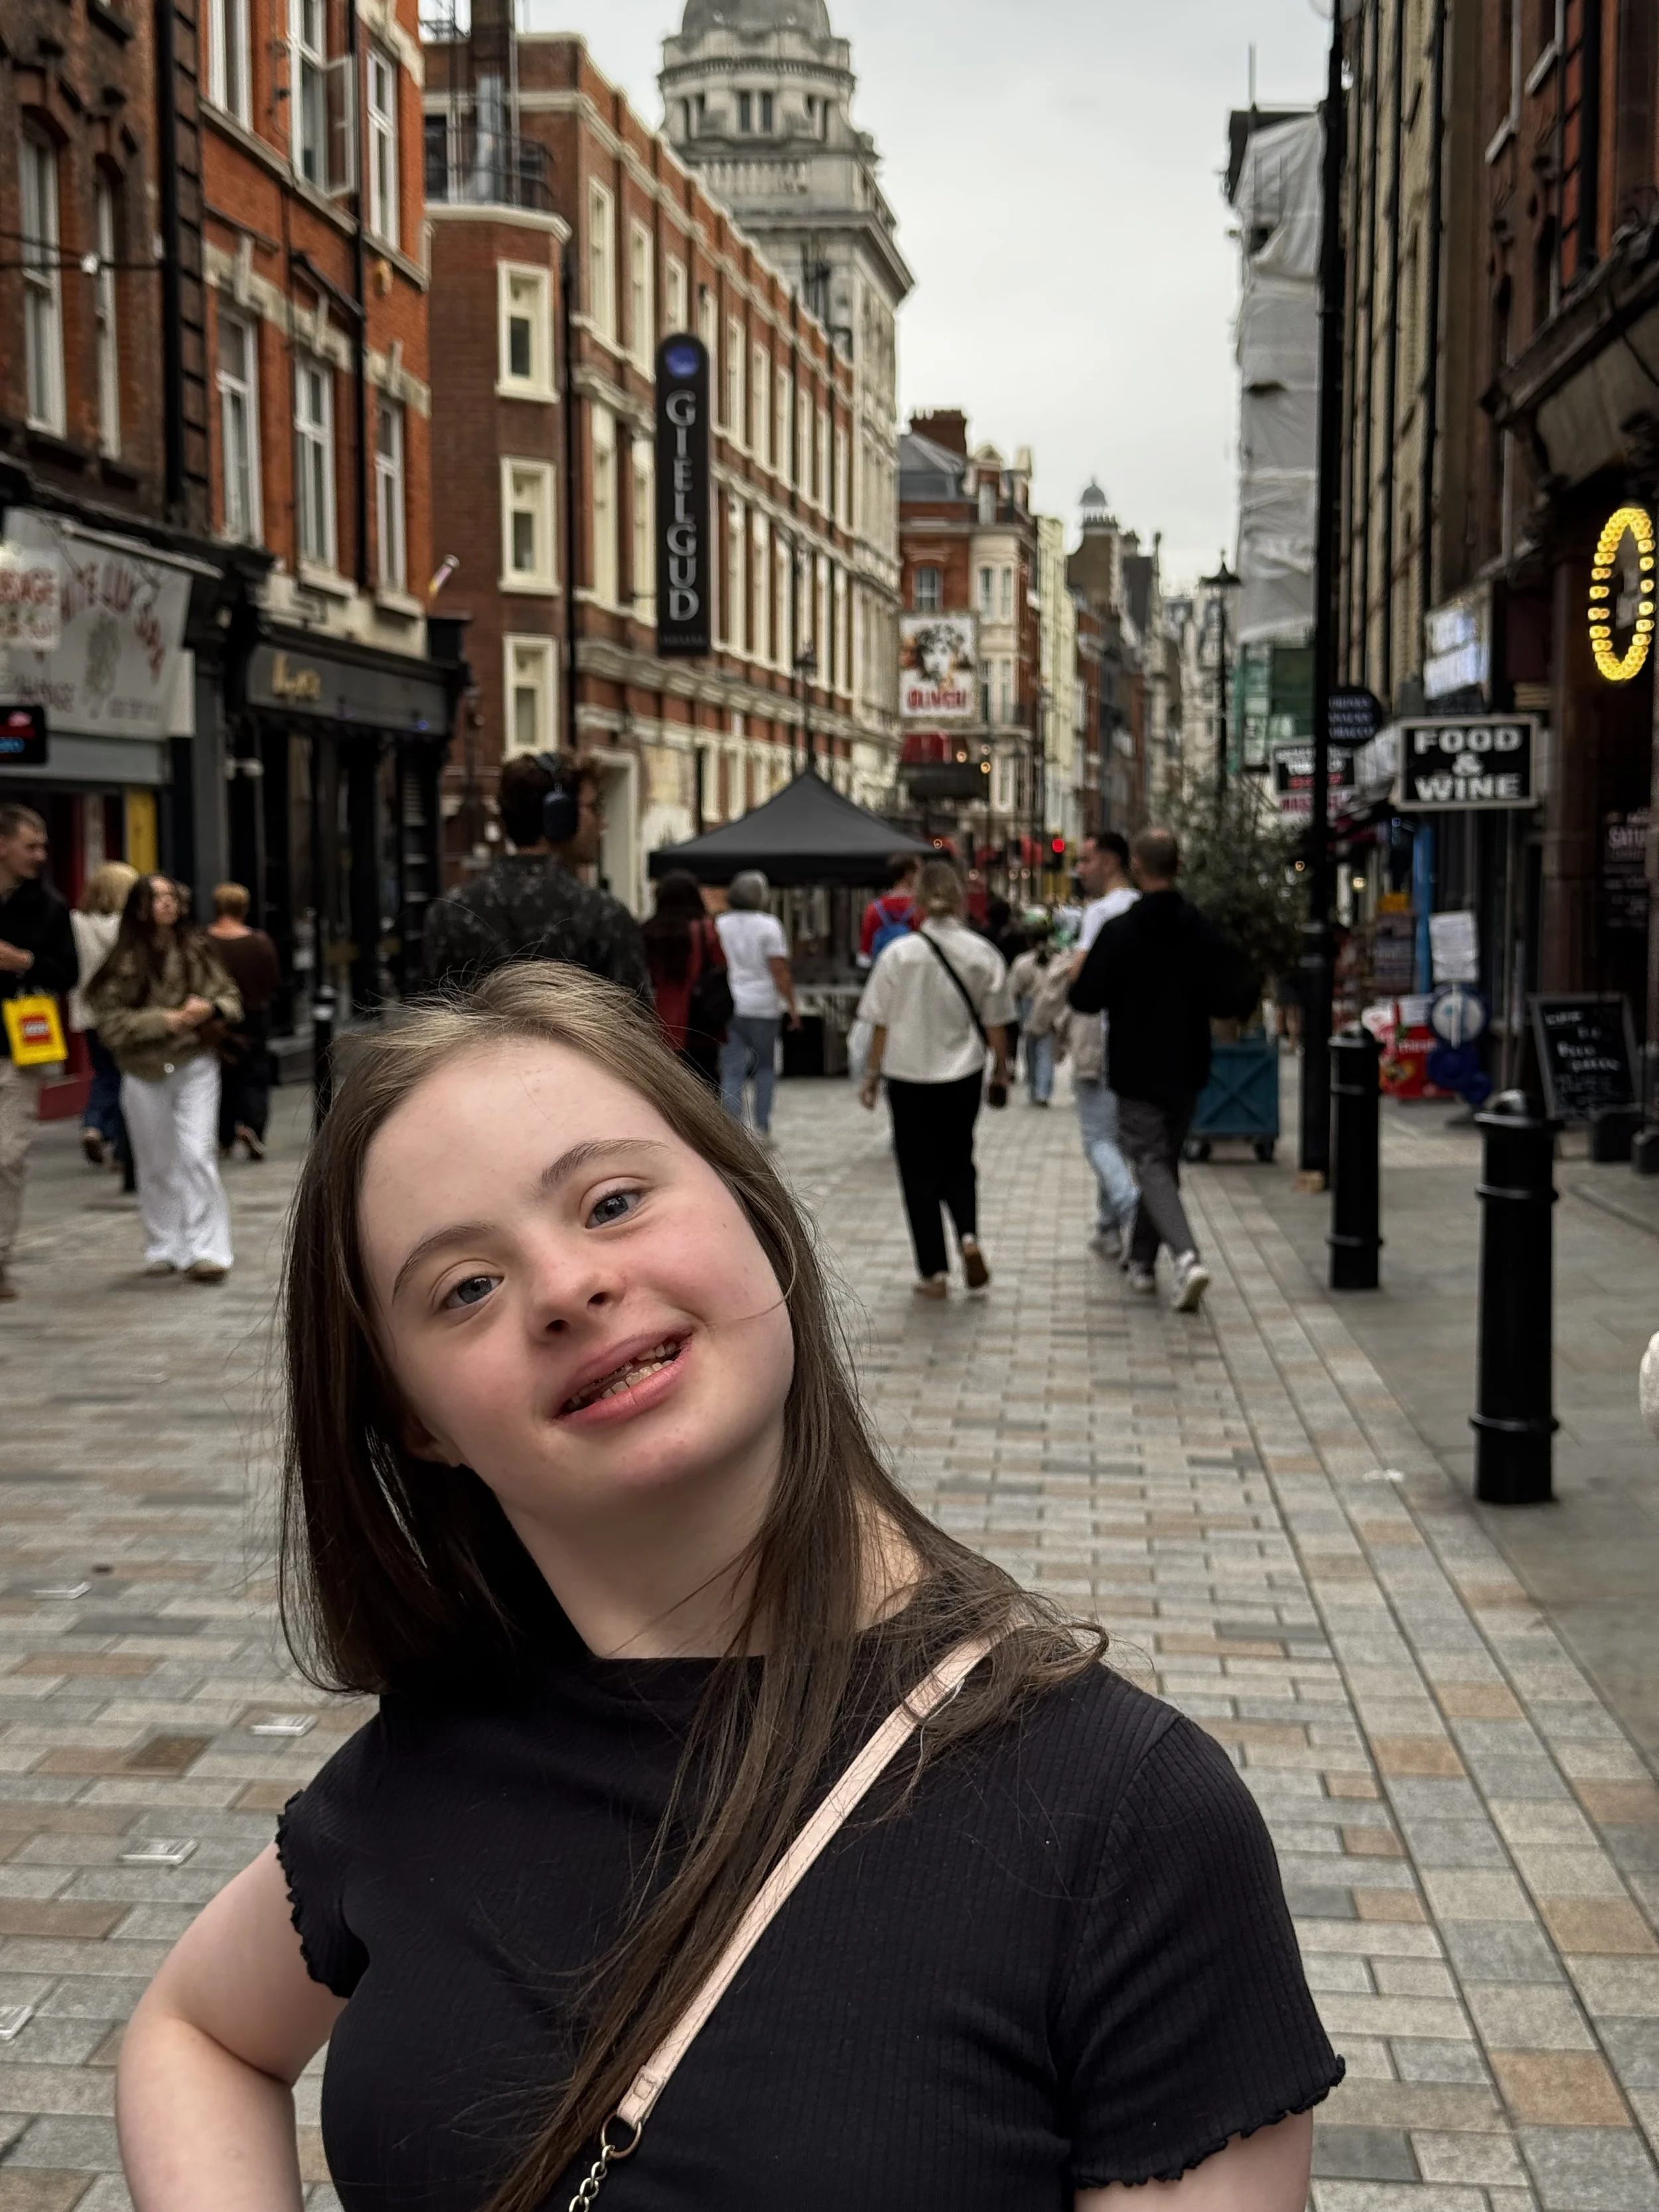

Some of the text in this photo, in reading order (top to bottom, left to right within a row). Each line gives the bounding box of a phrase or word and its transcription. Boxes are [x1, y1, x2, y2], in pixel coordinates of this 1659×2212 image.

[666, 390, 699, 621] GIELGUD
[1414, 727, 1523, 755] FOOD
[1451, 751, 1484, 776] &
[1414, 773, 1523, 801] WINE
